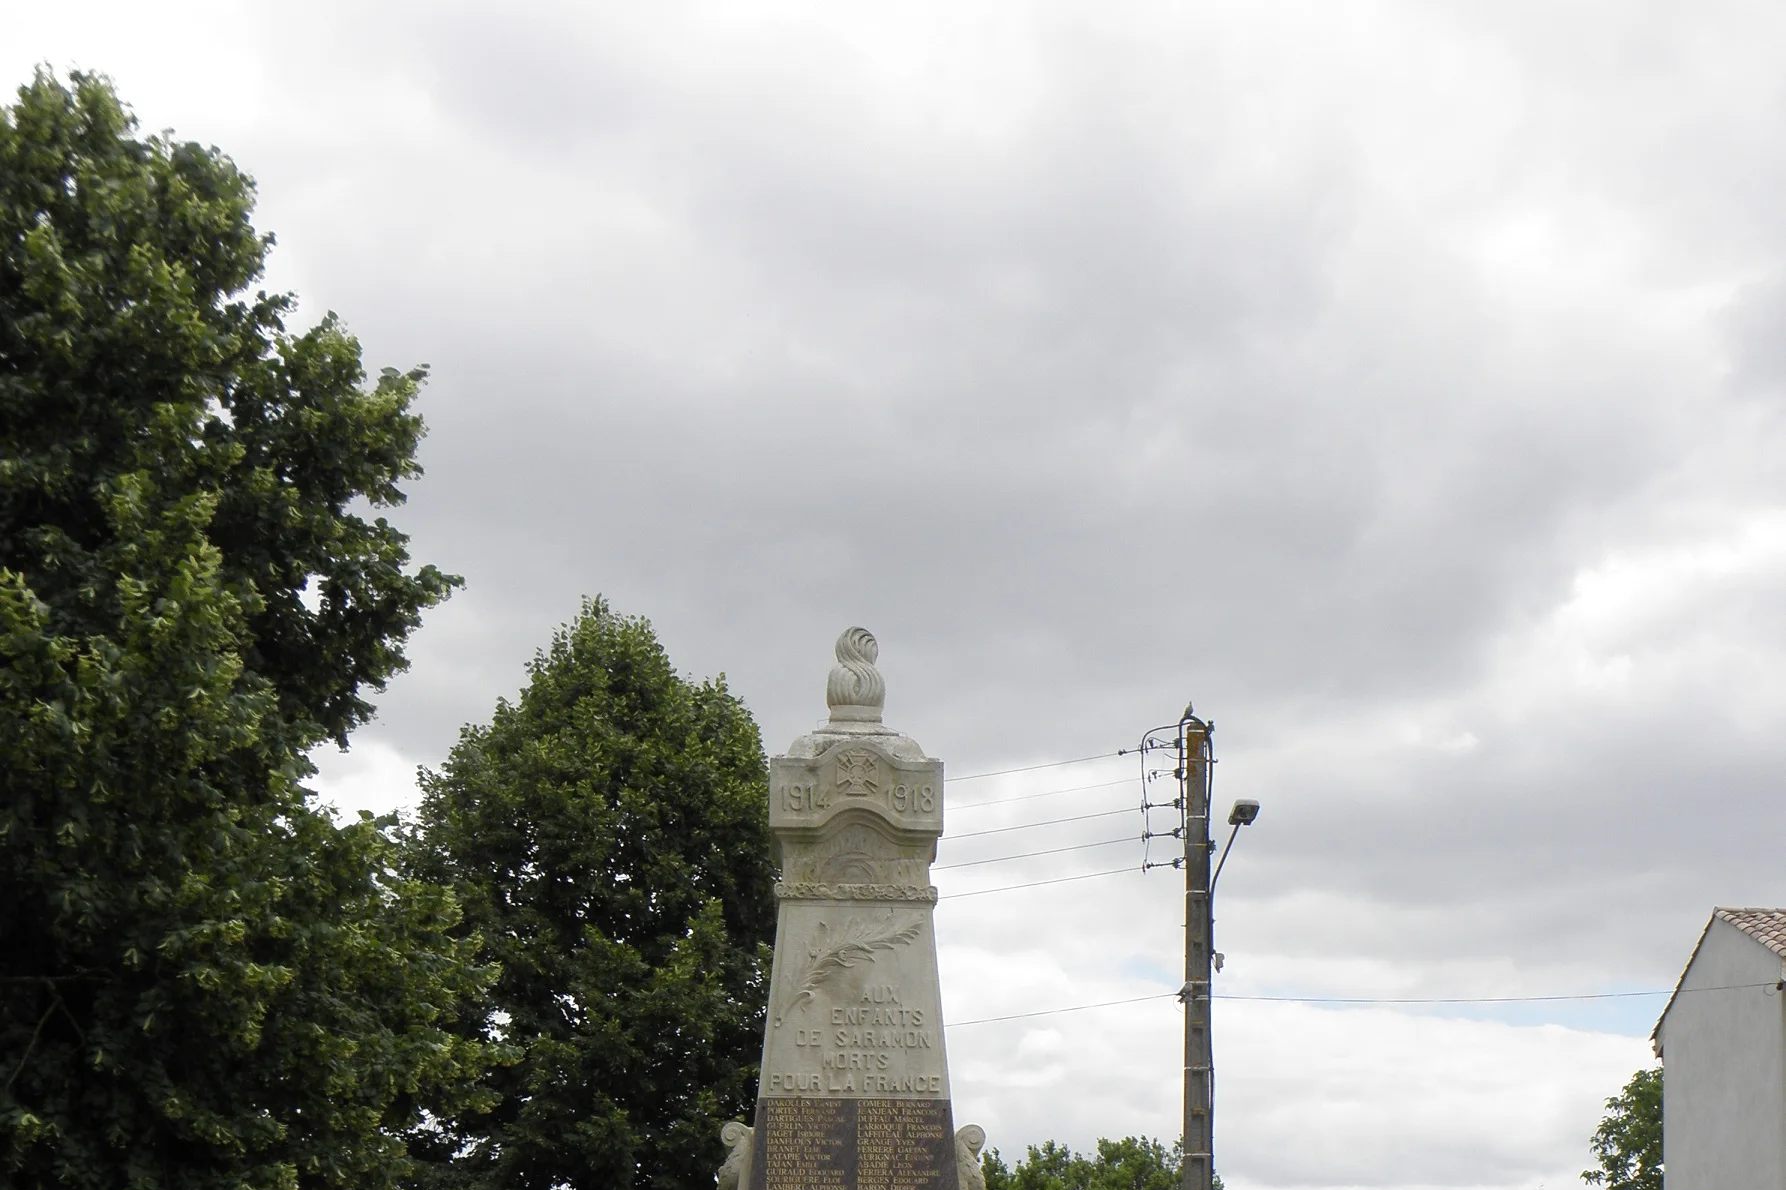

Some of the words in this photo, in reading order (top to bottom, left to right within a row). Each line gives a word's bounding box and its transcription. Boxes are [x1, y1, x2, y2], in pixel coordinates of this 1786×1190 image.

[780, 784, 831, 812] 1914
[886, 784, 934, 813] 1918
[860, 985, 900, 1004] AUX
[831, 1007, 925, 1027] ENFANTS
[795, 1030, 822, 1047] DE
[835, 1030, 931, 1048] SARAMON
[821, 1051, 889, 1070] MORTS
[769, 1072, 822, 1091] POUR
[828, 1073, 855, 1092] LA
[863, 1074, 942, 1093] FRANCE
